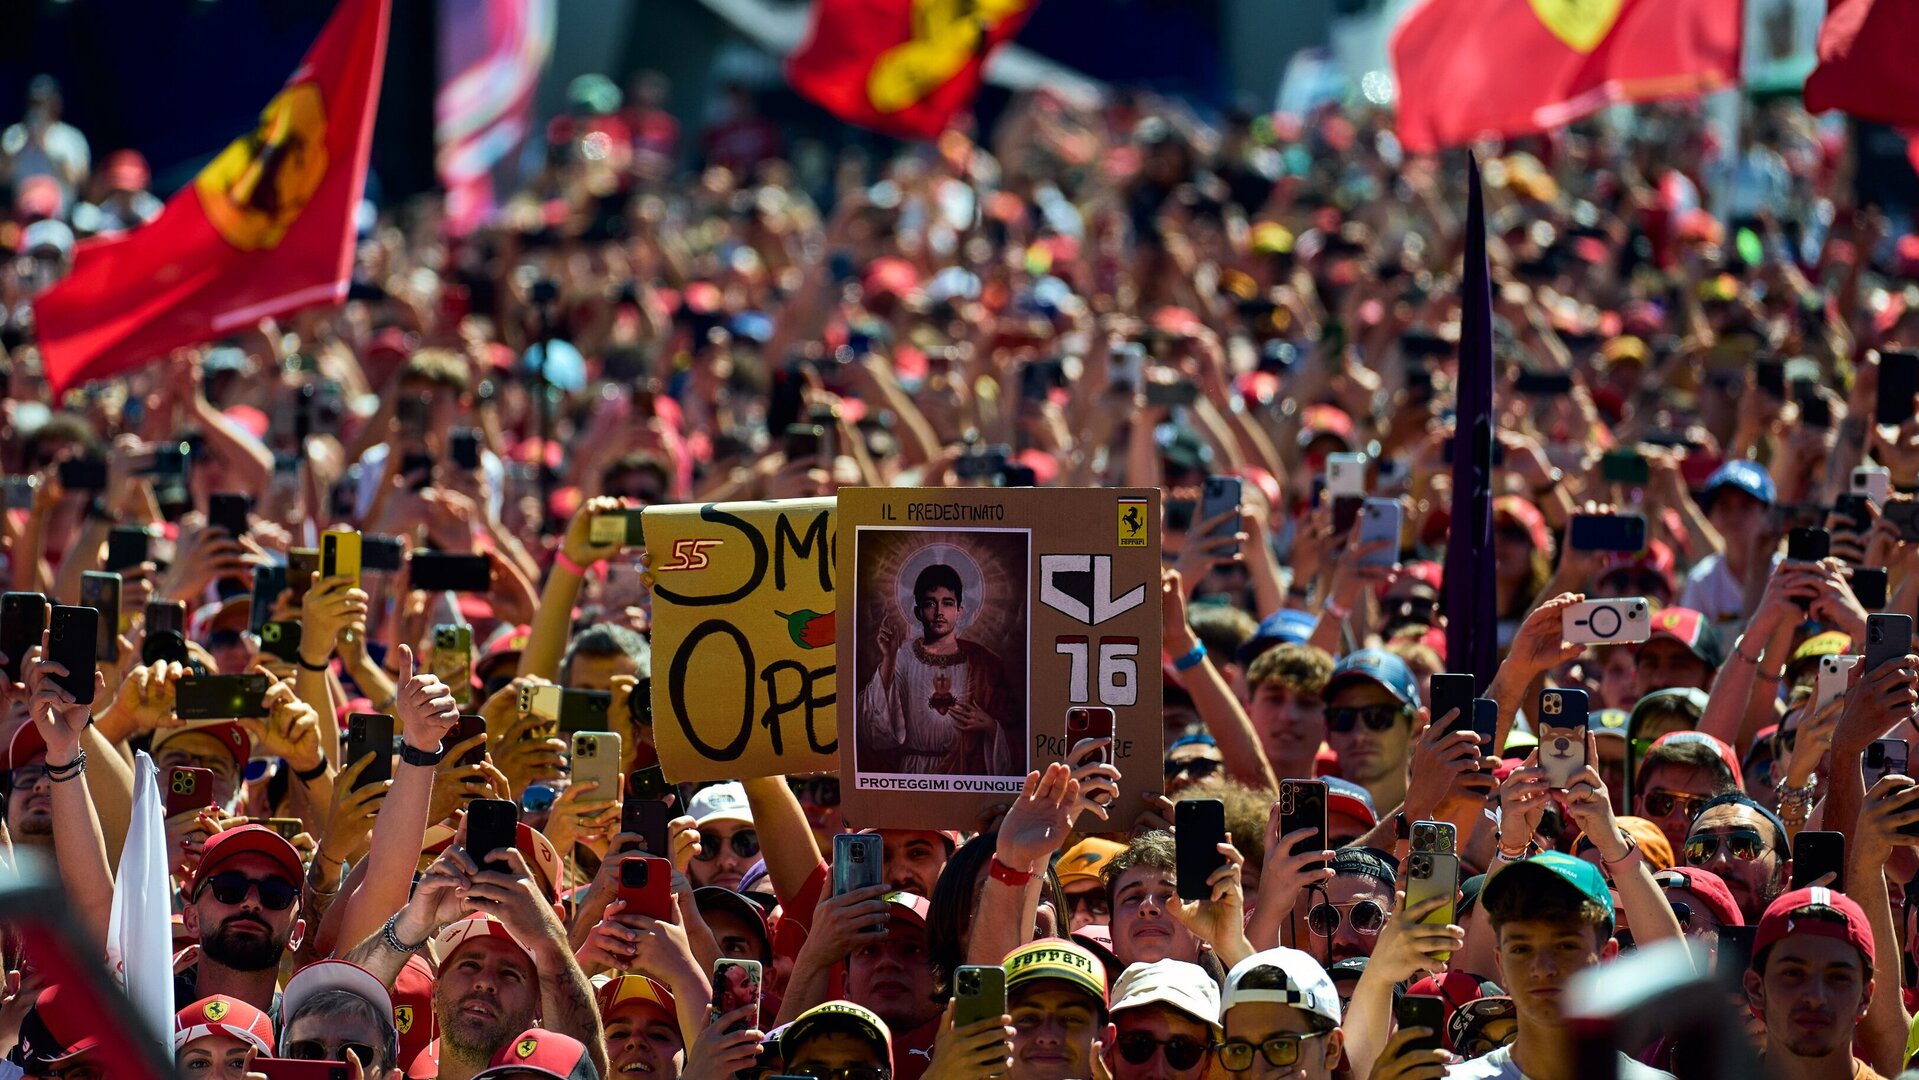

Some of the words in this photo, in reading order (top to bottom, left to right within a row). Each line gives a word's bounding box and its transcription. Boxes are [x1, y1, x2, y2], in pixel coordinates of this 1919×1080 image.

[881, 503, 897, 521] IL
[907, 502, 1005, 522] PREDESTINATO
[653, 503, 838, 607] SM
[657, 538, 725, 573] 55
[1039, 553, 1147, 627] CL
[1055, 634, 1140, 707] 16
[859, 777, 950, 791] PROTEGGIMI
[953, 779, 1025, 792] OVUNQUE
[1011, 949, 1093, 975] Ferrari
